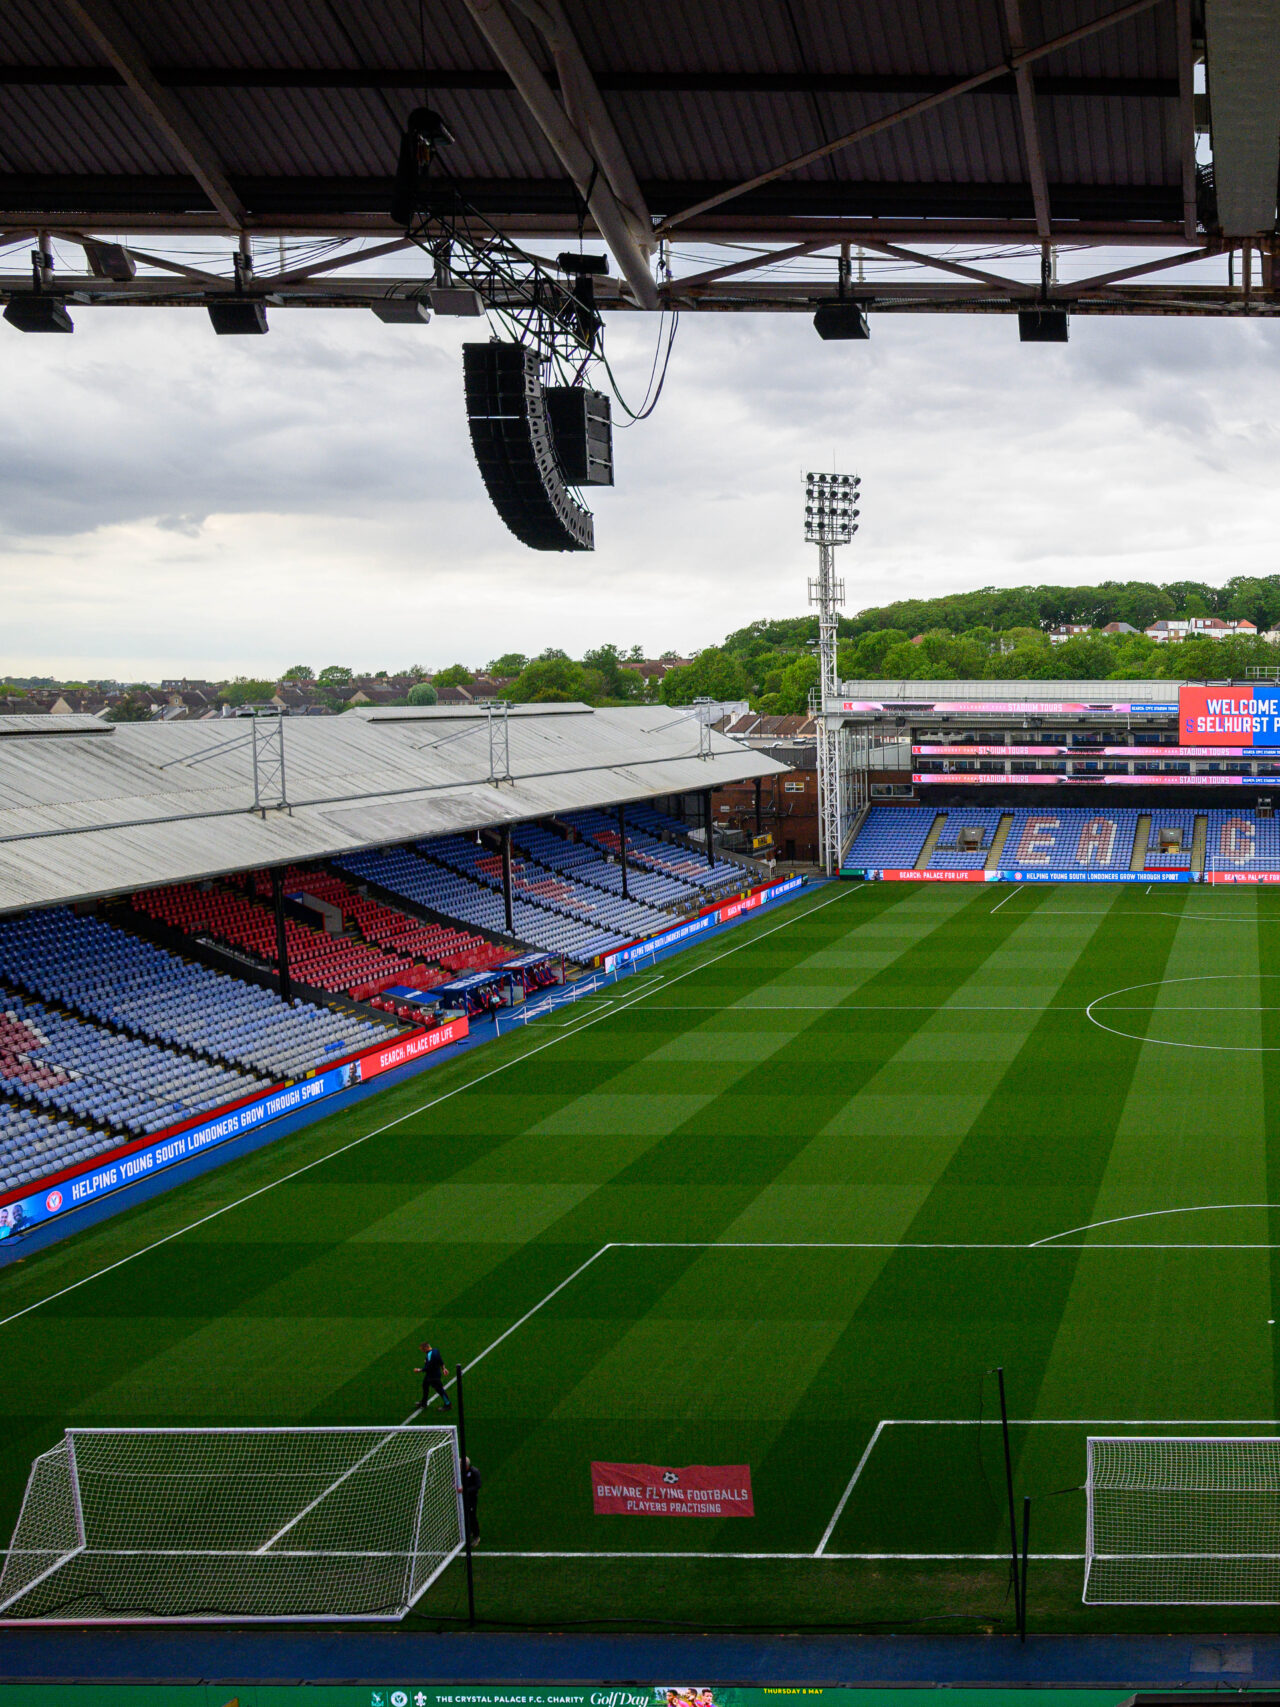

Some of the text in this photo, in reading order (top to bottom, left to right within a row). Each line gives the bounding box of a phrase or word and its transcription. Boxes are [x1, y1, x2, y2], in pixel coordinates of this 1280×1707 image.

[1040, 703, 1063, 712] TOURS
[1207, 699, 1278, 715] WELCOME
[1197, 717, 1270, 733] SELHURST
[1209, 747, 1230, 756] TOURS
[1209, 776, 1229, 784] TOURS
[923, 871, 943, 879] PALACE
[945, 871, 956, 879] FOR
[957, 871, 968, 879] LIFE
[1026, 872, 1048, 880] HELPING
[1049, 872, 1068, 880] YOUNG
[1069, 872, 1086, 880] SOUTH
[1119, 872, 1135, 880] GROW
[1137, 872, 1160, 880] THROUGH
[1161, 872, 1179, 880] SPORT
[1270, 873, 1280, 881] FOR
[380, 1026, 453, 1068] SEARCH: PALACE FOR LIFE
[72, 1079, 325, 1201] HELPING YOUNG SOUTH LONDONERS GROW THROUGH SPORT
[597, 1485, 748, 1501] BEWARE FLYING FOOTBALLS
[626, 1501, 721, 1513] PLAYERS PRACTISING
